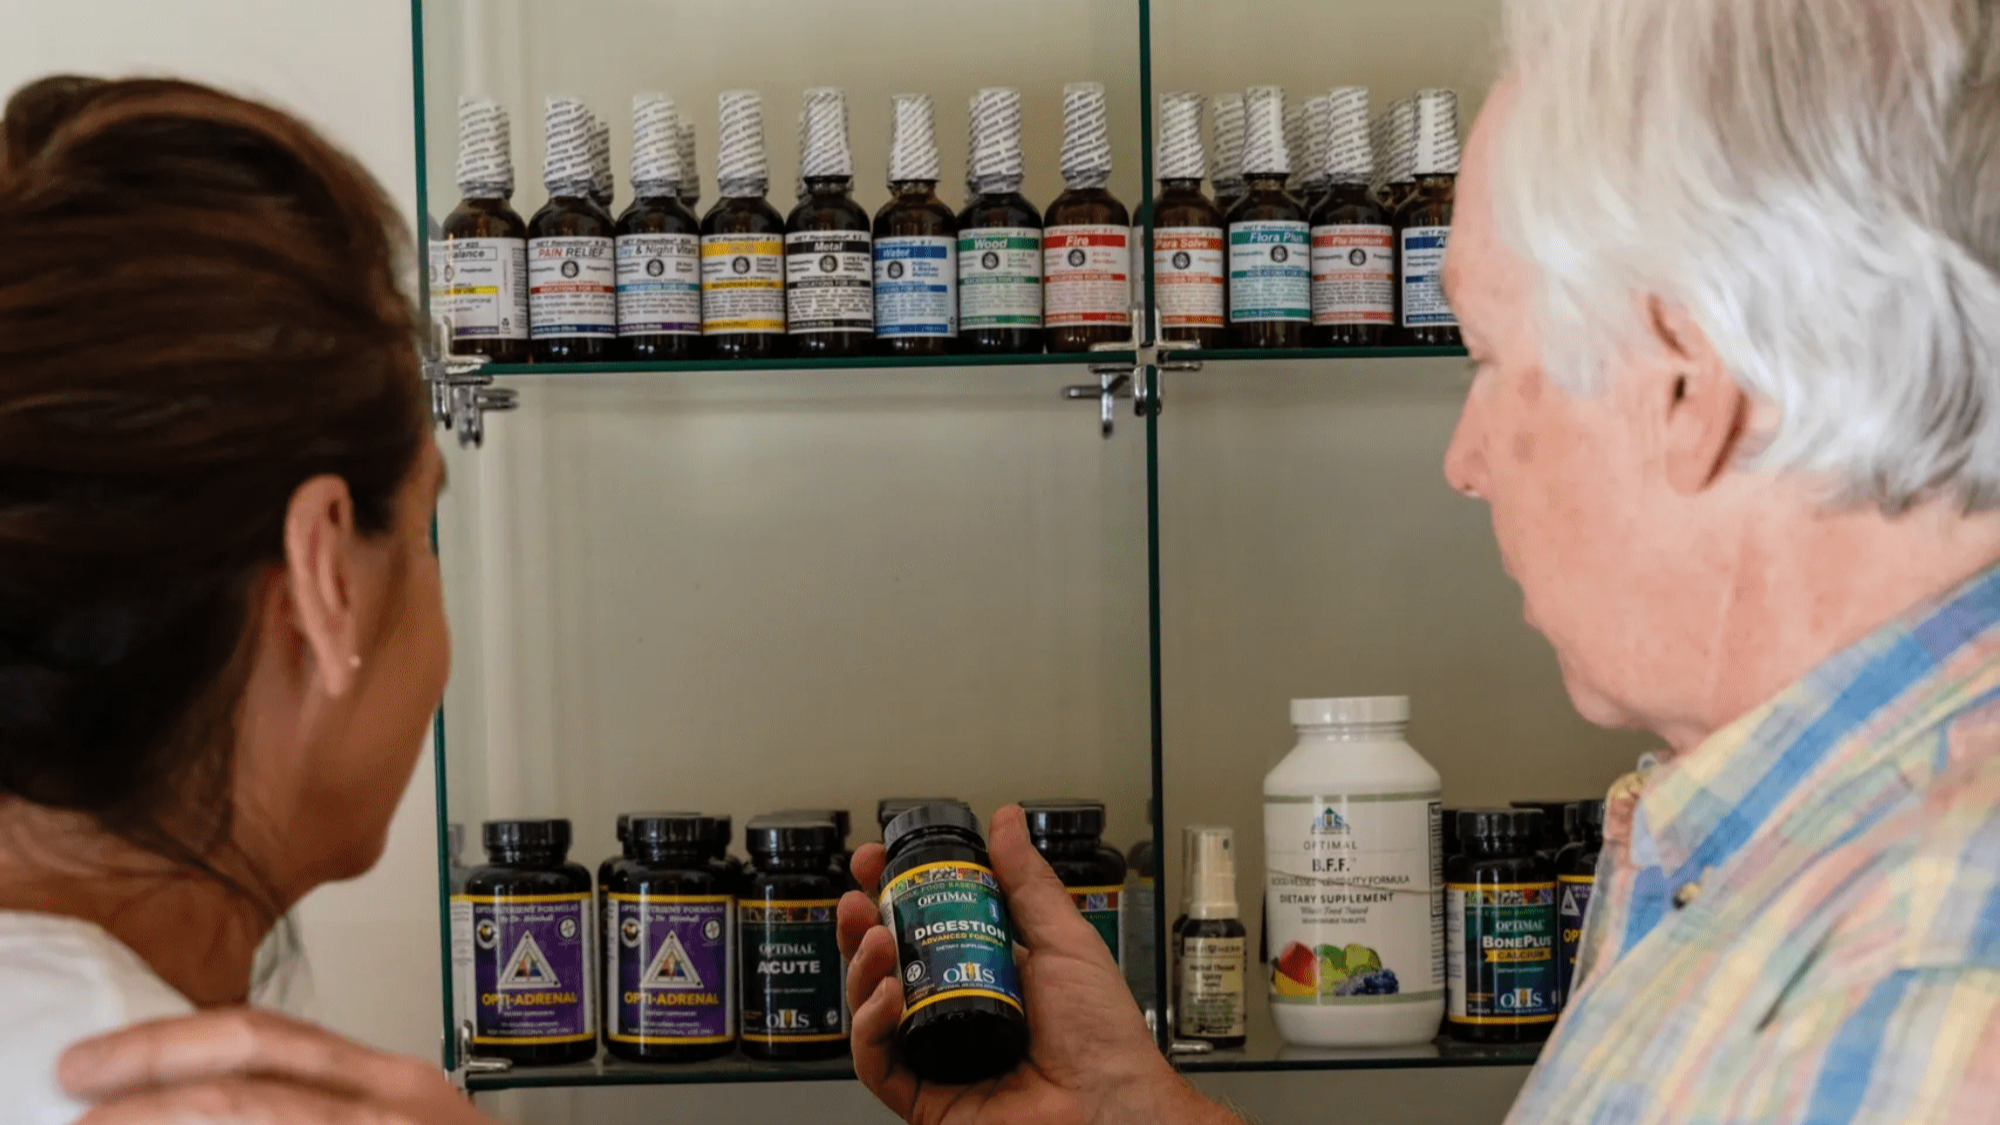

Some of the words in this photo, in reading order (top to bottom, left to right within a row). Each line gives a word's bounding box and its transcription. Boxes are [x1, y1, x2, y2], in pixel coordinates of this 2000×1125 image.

[974, 238, 1008, 249] Wood
[1065, 236, 1090, 247] Fire
[1250, 231, 1280, 244] Flora
[1282, 232, 1304, 243] Plus
[813, 241, 843, 251] Metal
[1154, 239, 1178, 249] Para
[452, 248, 485, 259] alance
[538, 247, 564, 259] PAIN
[566, 247, 605, 259] RELIEF
[635, 246, 642, 254] &
[645, 245, 673, 257] Night
[882, 247, 911, 257] Water
[1303, 840, 1357, 851] OPTIMAL
[1311, 857, 1351, 873] B.F.F.
[1368, 875, 1410, 886] FORMULA
[917, 890, 977, 907] OPTIMAL
[1279, 894, 1317, 904] DIETARY
[914, 919, 1007, 943] DIGESTION
[1495, 918, 1545, 932] OPTIMAL
[921, 932, 967, 948] ADVANCED
[968, 932, 1005, 948] FORMULA
[758, 942, 816, 956] OPTIMAL
[757, 960, 821, 975] ACUTE
[481, 991, 577, 1006] OPTI-ADRENAL
[623, 991, 720, 1006] OPTI-ADRENAL
